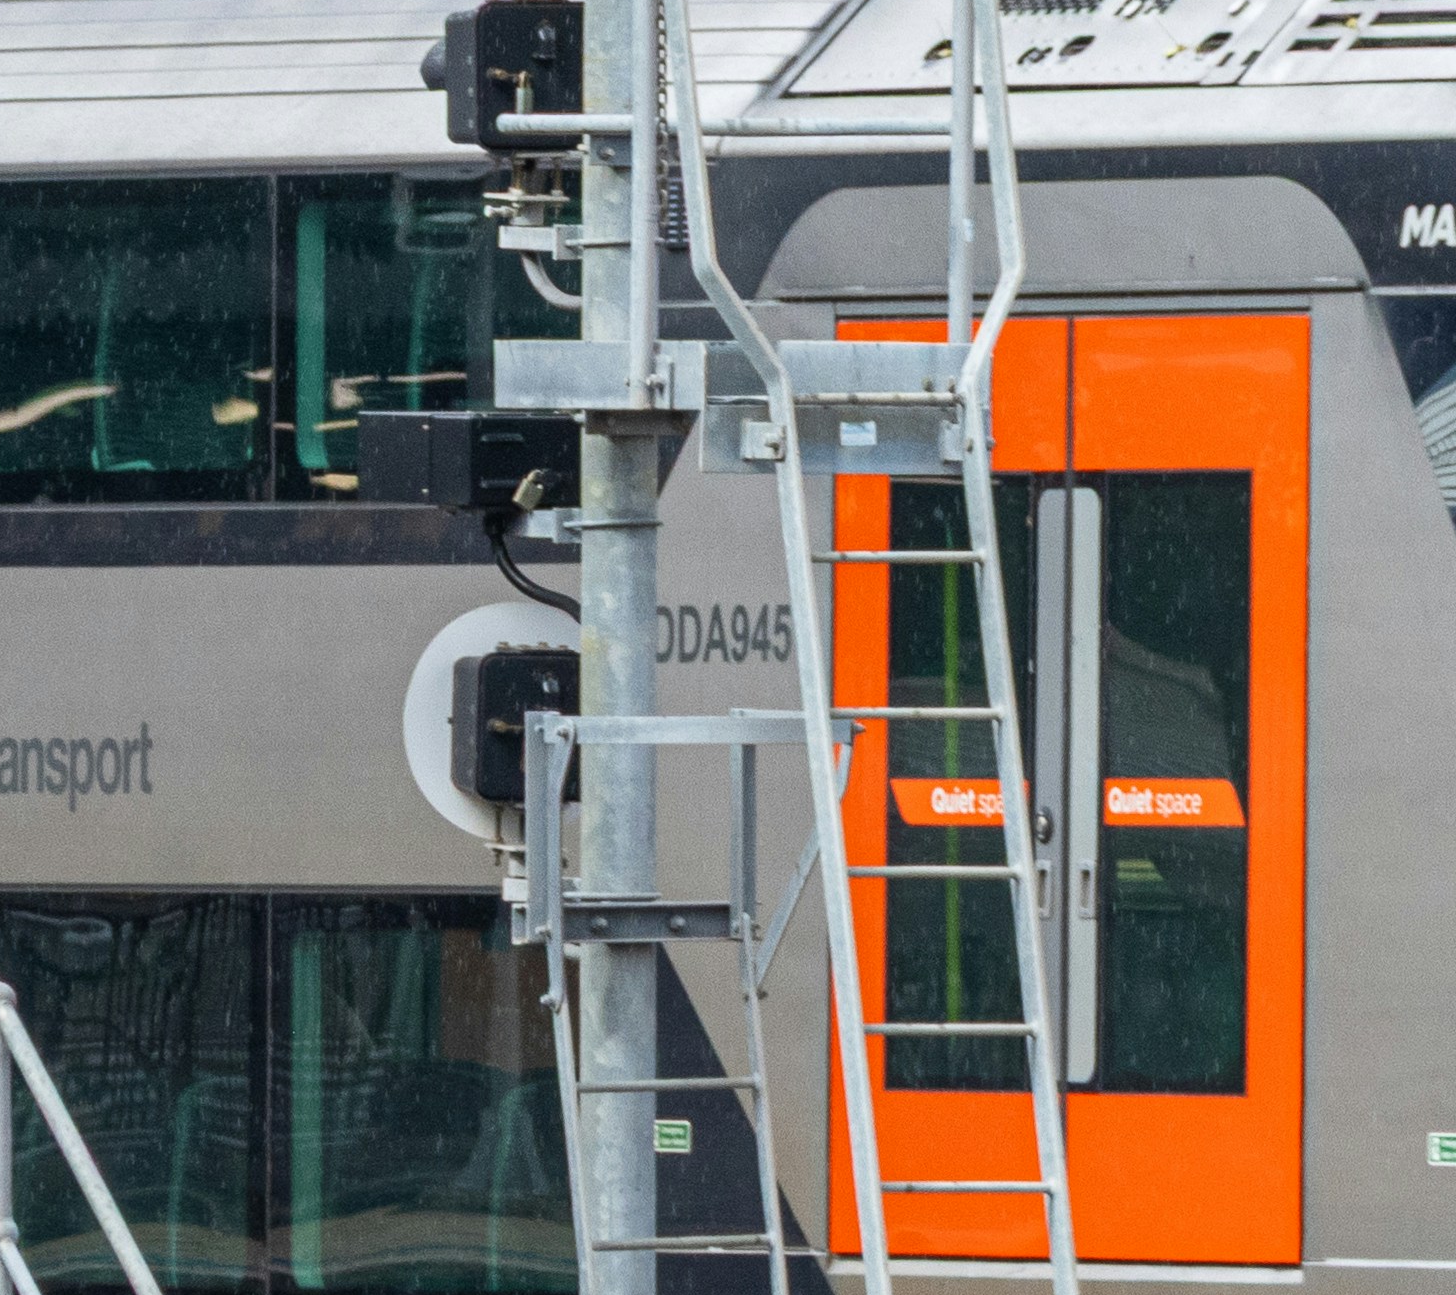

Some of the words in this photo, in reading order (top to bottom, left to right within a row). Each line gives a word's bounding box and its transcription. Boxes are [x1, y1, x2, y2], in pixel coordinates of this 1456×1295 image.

[931, 785, 976, 814] Quiet
[978, 793, 1004, 818] spa
[1108, 785, 1154, 814] Quiet
[1156, 792, 1203, 818] space
